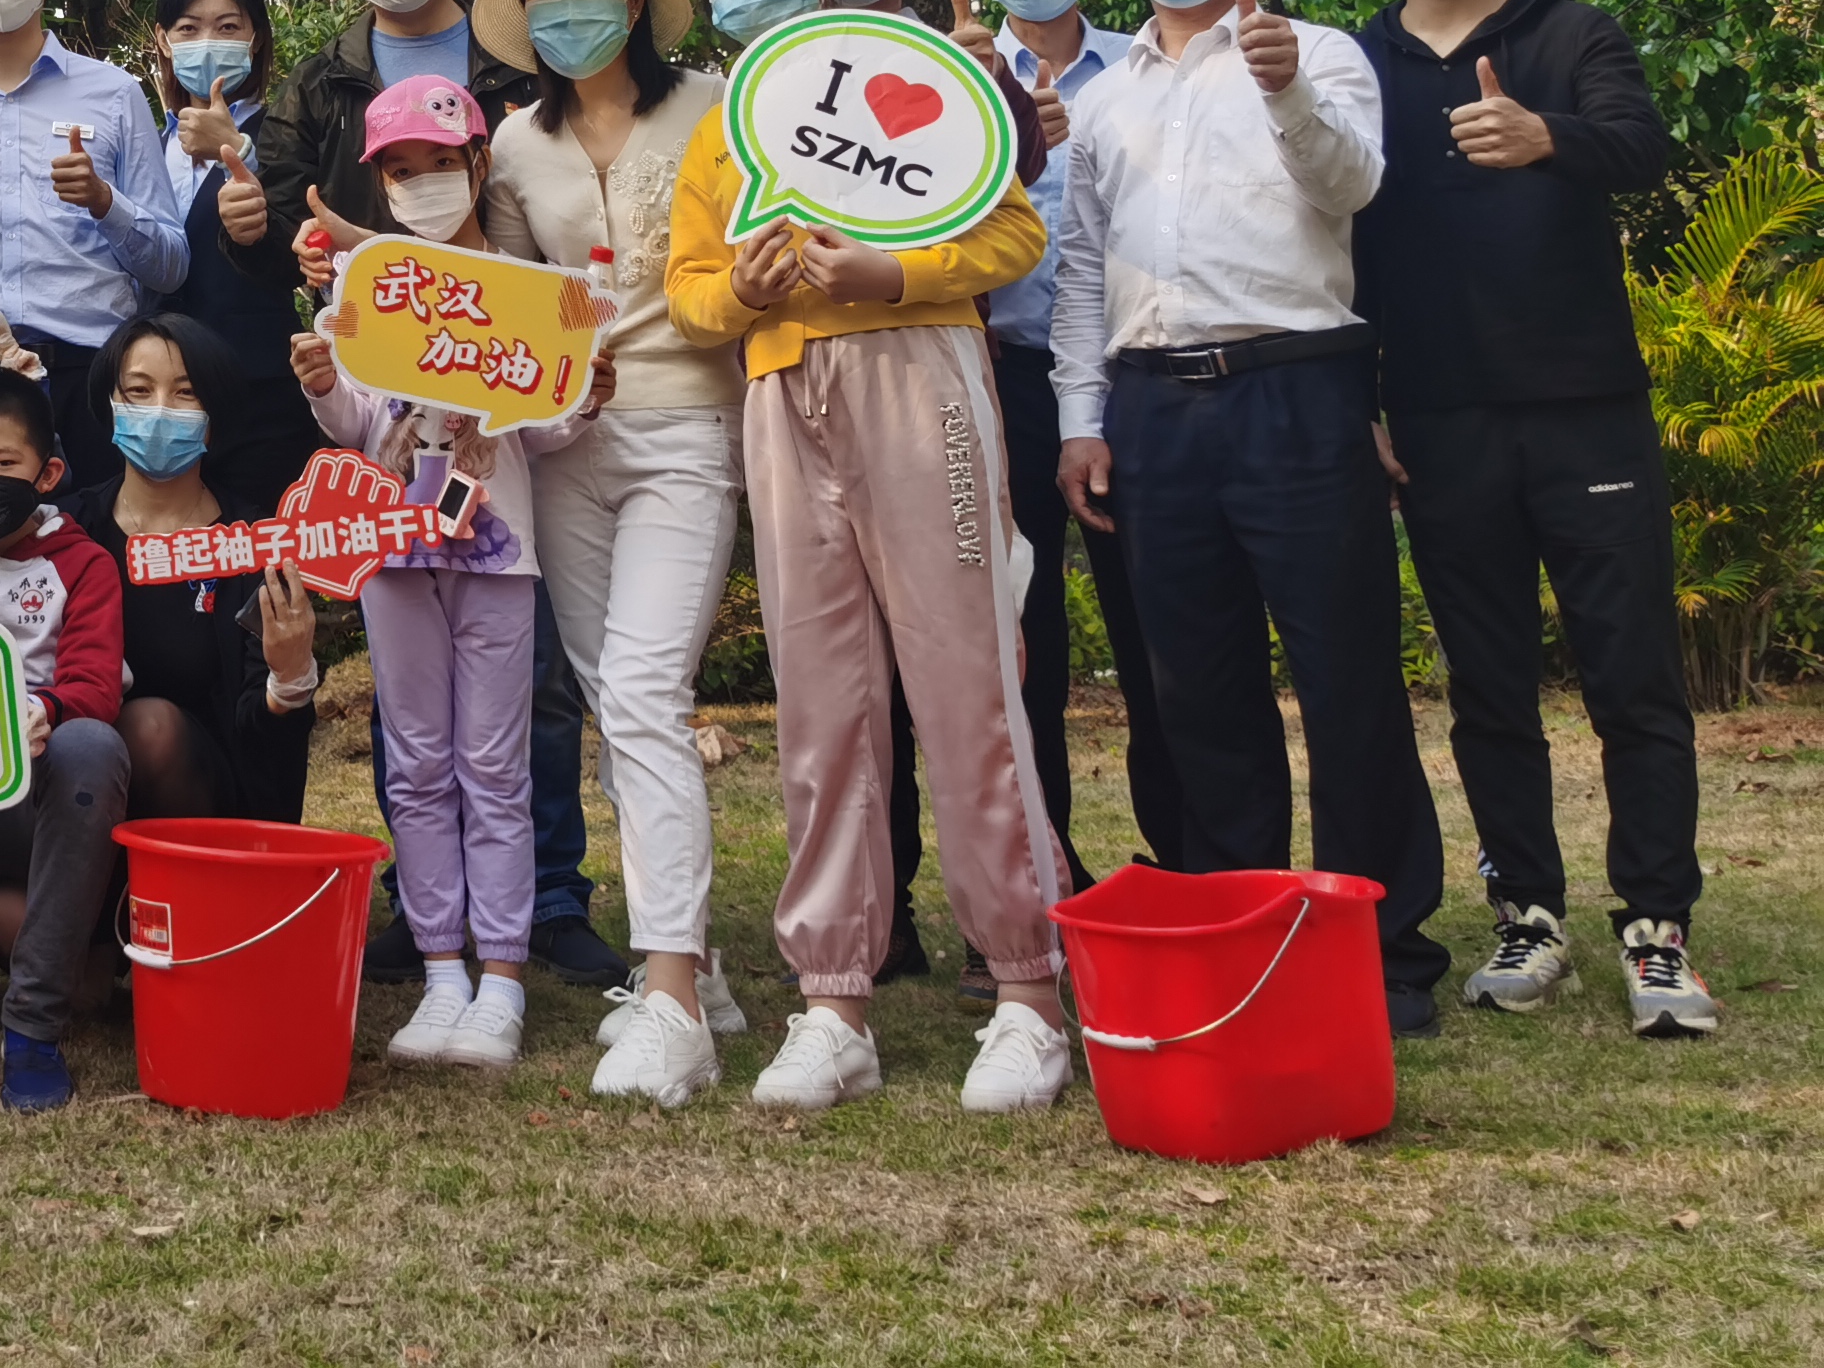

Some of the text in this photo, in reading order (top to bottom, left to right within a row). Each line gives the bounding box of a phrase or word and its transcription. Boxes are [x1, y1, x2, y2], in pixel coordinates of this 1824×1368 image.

[814, 58, 853, 116] I
[790, 125, 933, 197] SZMC
[373, 257, 493, 327] 武汉
[18, 614, 45, 624] 1999
